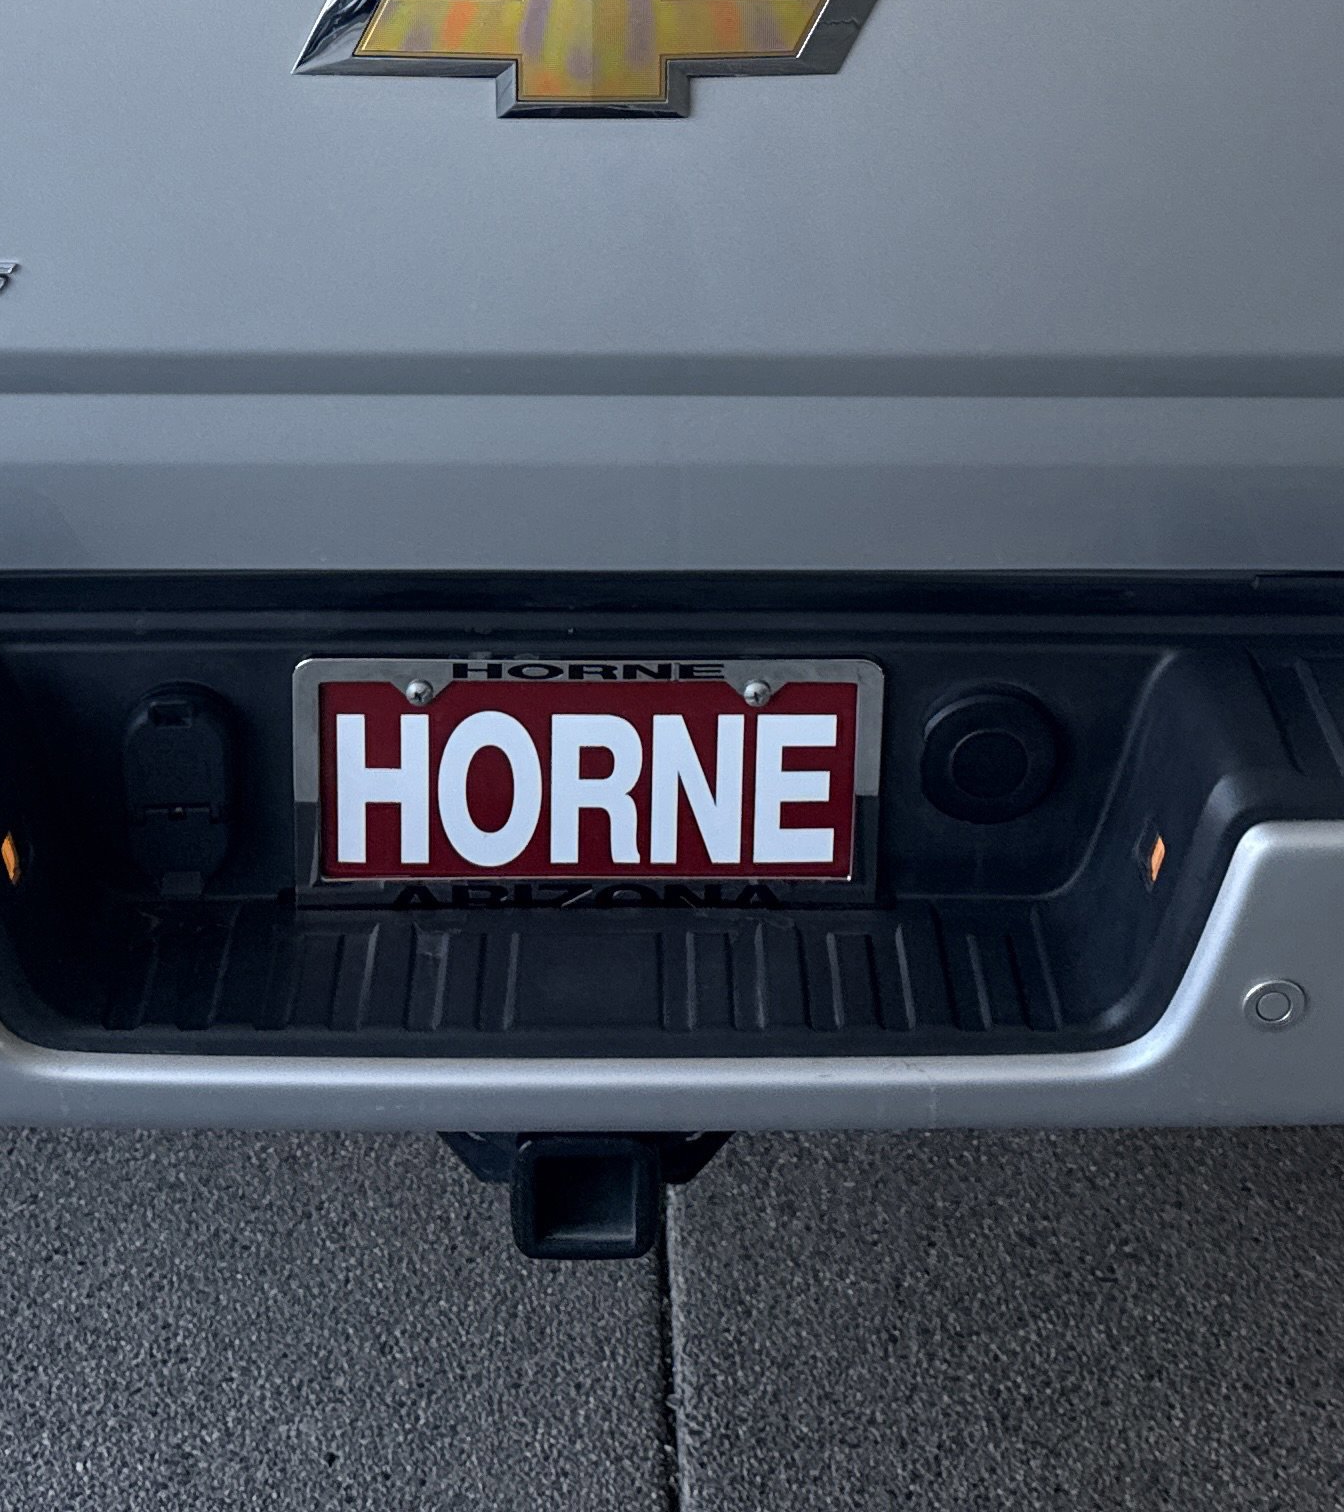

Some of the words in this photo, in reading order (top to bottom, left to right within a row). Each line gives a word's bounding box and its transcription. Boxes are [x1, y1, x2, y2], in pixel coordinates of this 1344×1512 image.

[452, 662, 725, 681] HORNE
[336, 710, 838, 868] HORNE
[393, 884, 784, 909] ARIZONA
